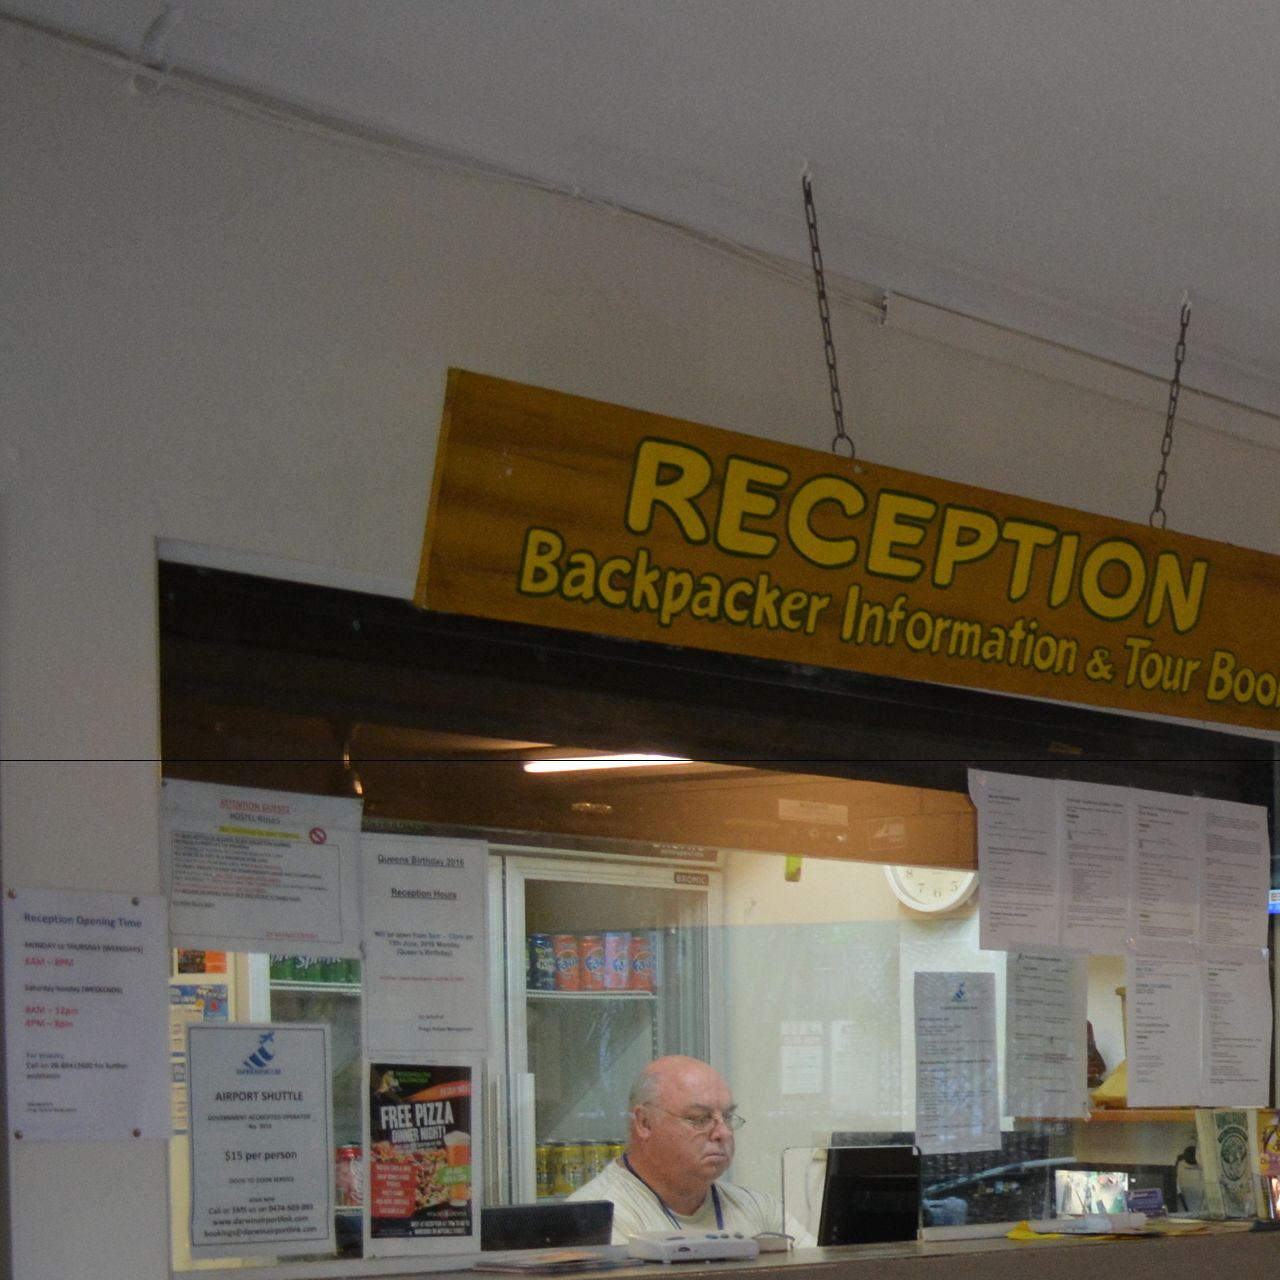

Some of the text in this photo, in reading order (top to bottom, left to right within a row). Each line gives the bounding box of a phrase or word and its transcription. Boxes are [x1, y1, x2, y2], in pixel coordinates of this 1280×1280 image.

[624, 438, 1210, 635] RECEPTION
[518, 528, 829, 637] Backpacker
[840, 584, 1078, 676] Information
[1086, 646, 1114, 682] &
[1124, 635, 1200, 694] Tour
[410, 855, 445, 868] Birthday
[390, 887, 457, 900] Reception Hours
[24, 912, 142, 929] Reception Opening Time
[24, 941, 57, 950] MONDAY
[66, 943, 101, 952] THURSDAY
[215, 1090, 304, 1101] AIRPORT SHUTTLE
[380, 1101, 454, 1130] FREE PIZZA
[391, 1125, 447, 1143] DINNER NIGHT!
[225, 1150, 298, 1163] $15 per person
